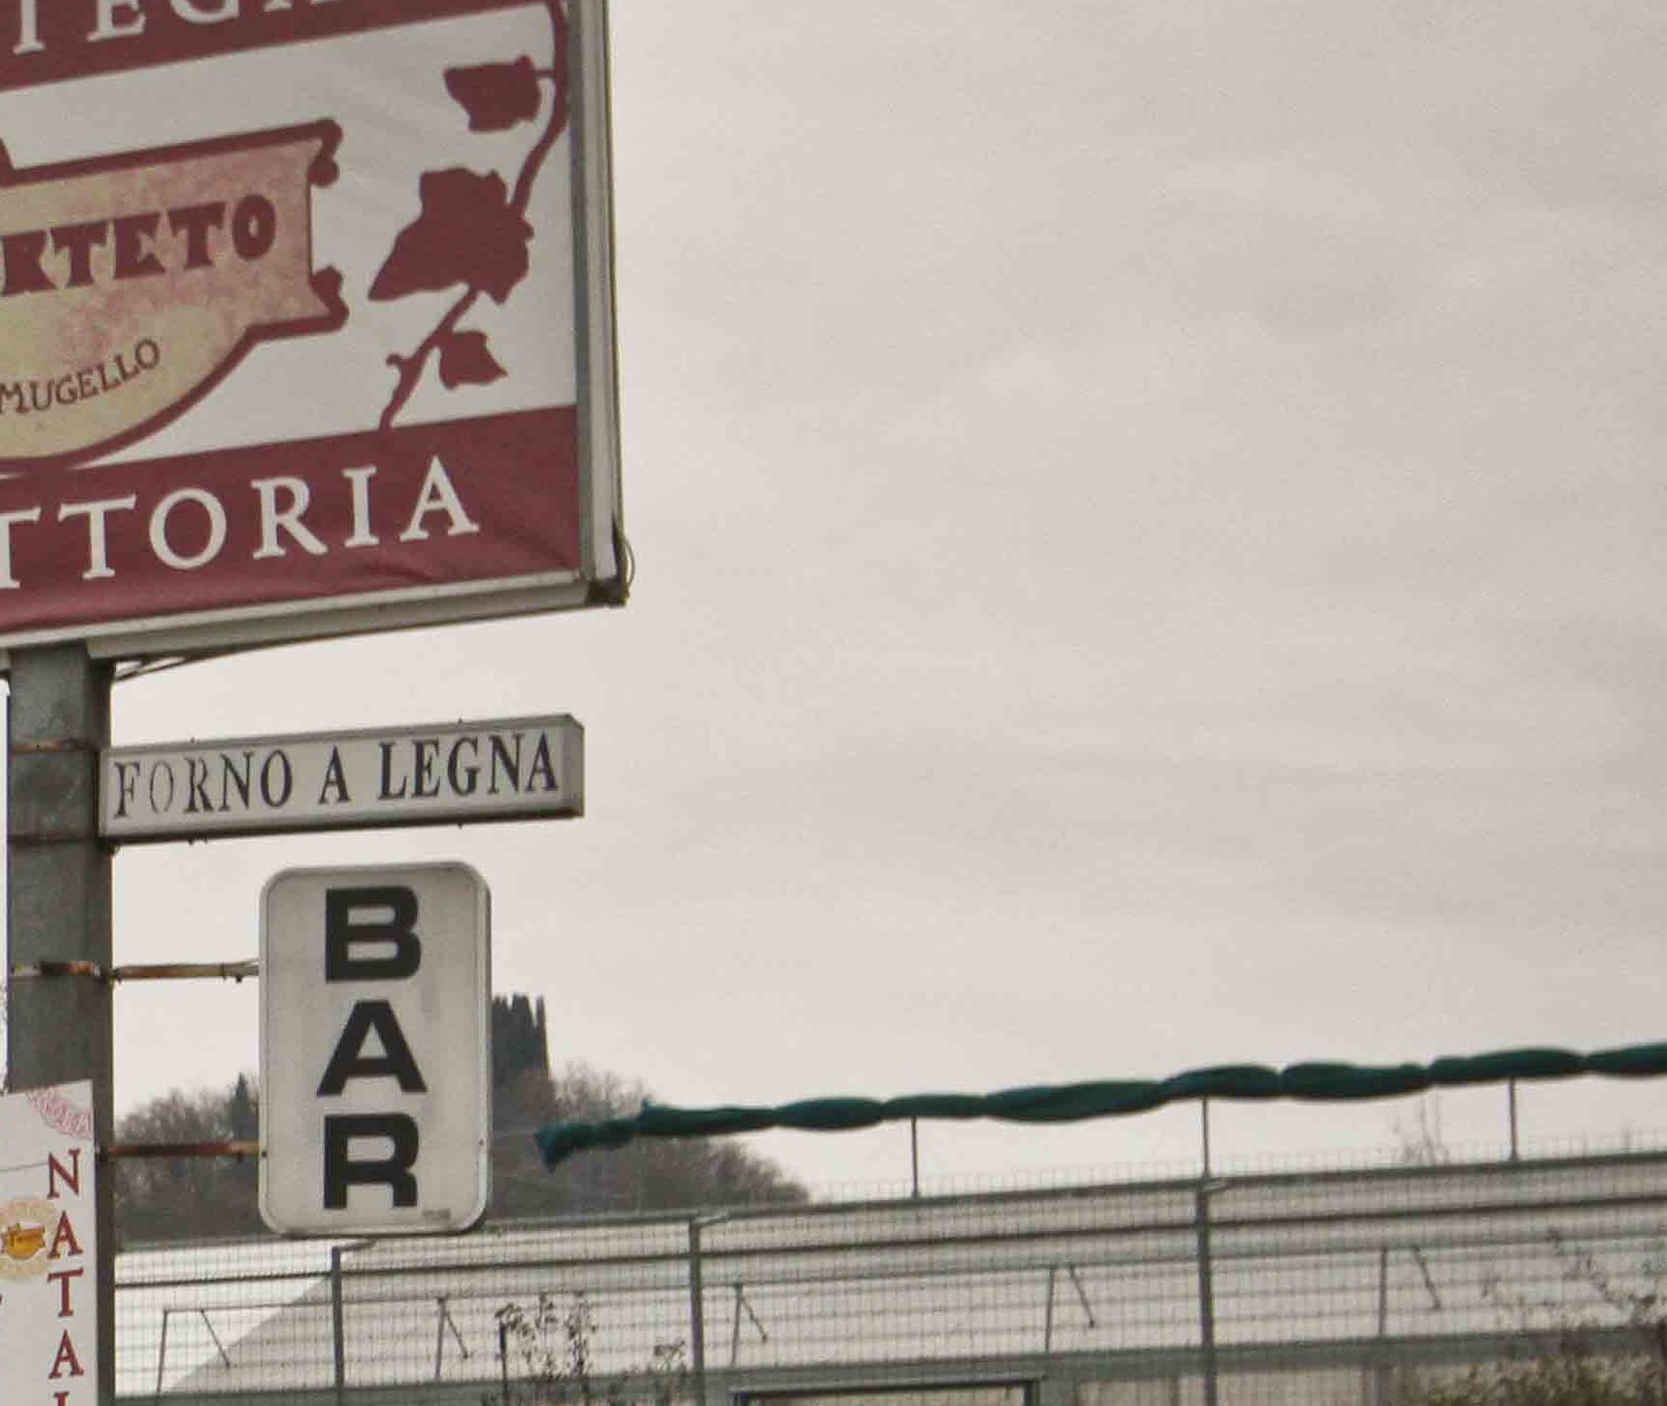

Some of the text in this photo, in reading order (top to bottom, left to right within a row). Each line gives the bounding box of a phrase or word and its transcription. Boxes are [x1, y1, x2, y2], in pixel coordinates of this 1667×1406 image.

[113, 730, 560, 819] FORNO A LEGNA
[316, 885, 427, 1210] BAR
